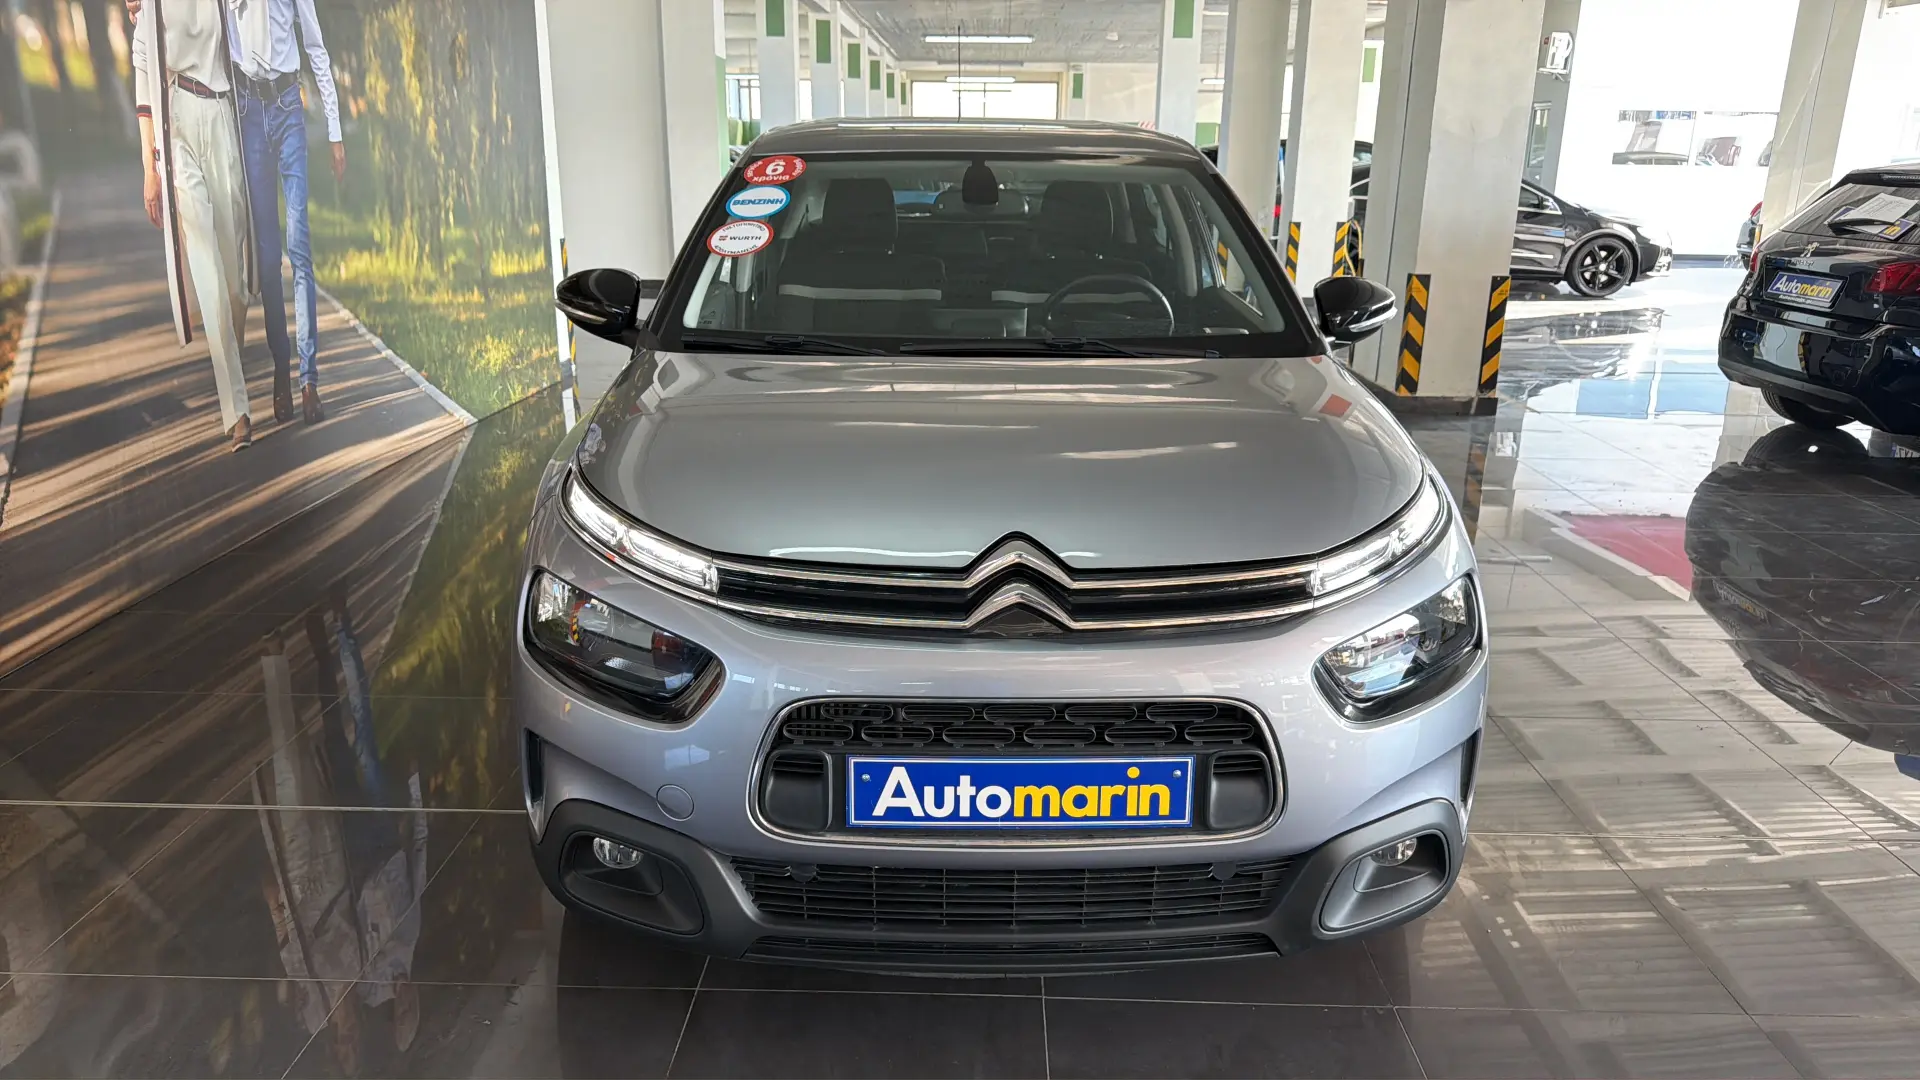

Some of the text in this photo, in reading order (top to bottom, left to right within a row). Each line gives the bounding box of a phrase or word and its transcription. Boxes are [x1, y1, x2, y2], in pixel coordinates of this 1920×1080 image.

[765, 161, 786, 175] 6
[752, 175, 790, 183] χρόνια
[732, 198, 784, 206] ΒΕΝΖΙΝΗ
[1773, 275, 1833, 298] Automarin
[872, 766, 1170, 818] Automarin
